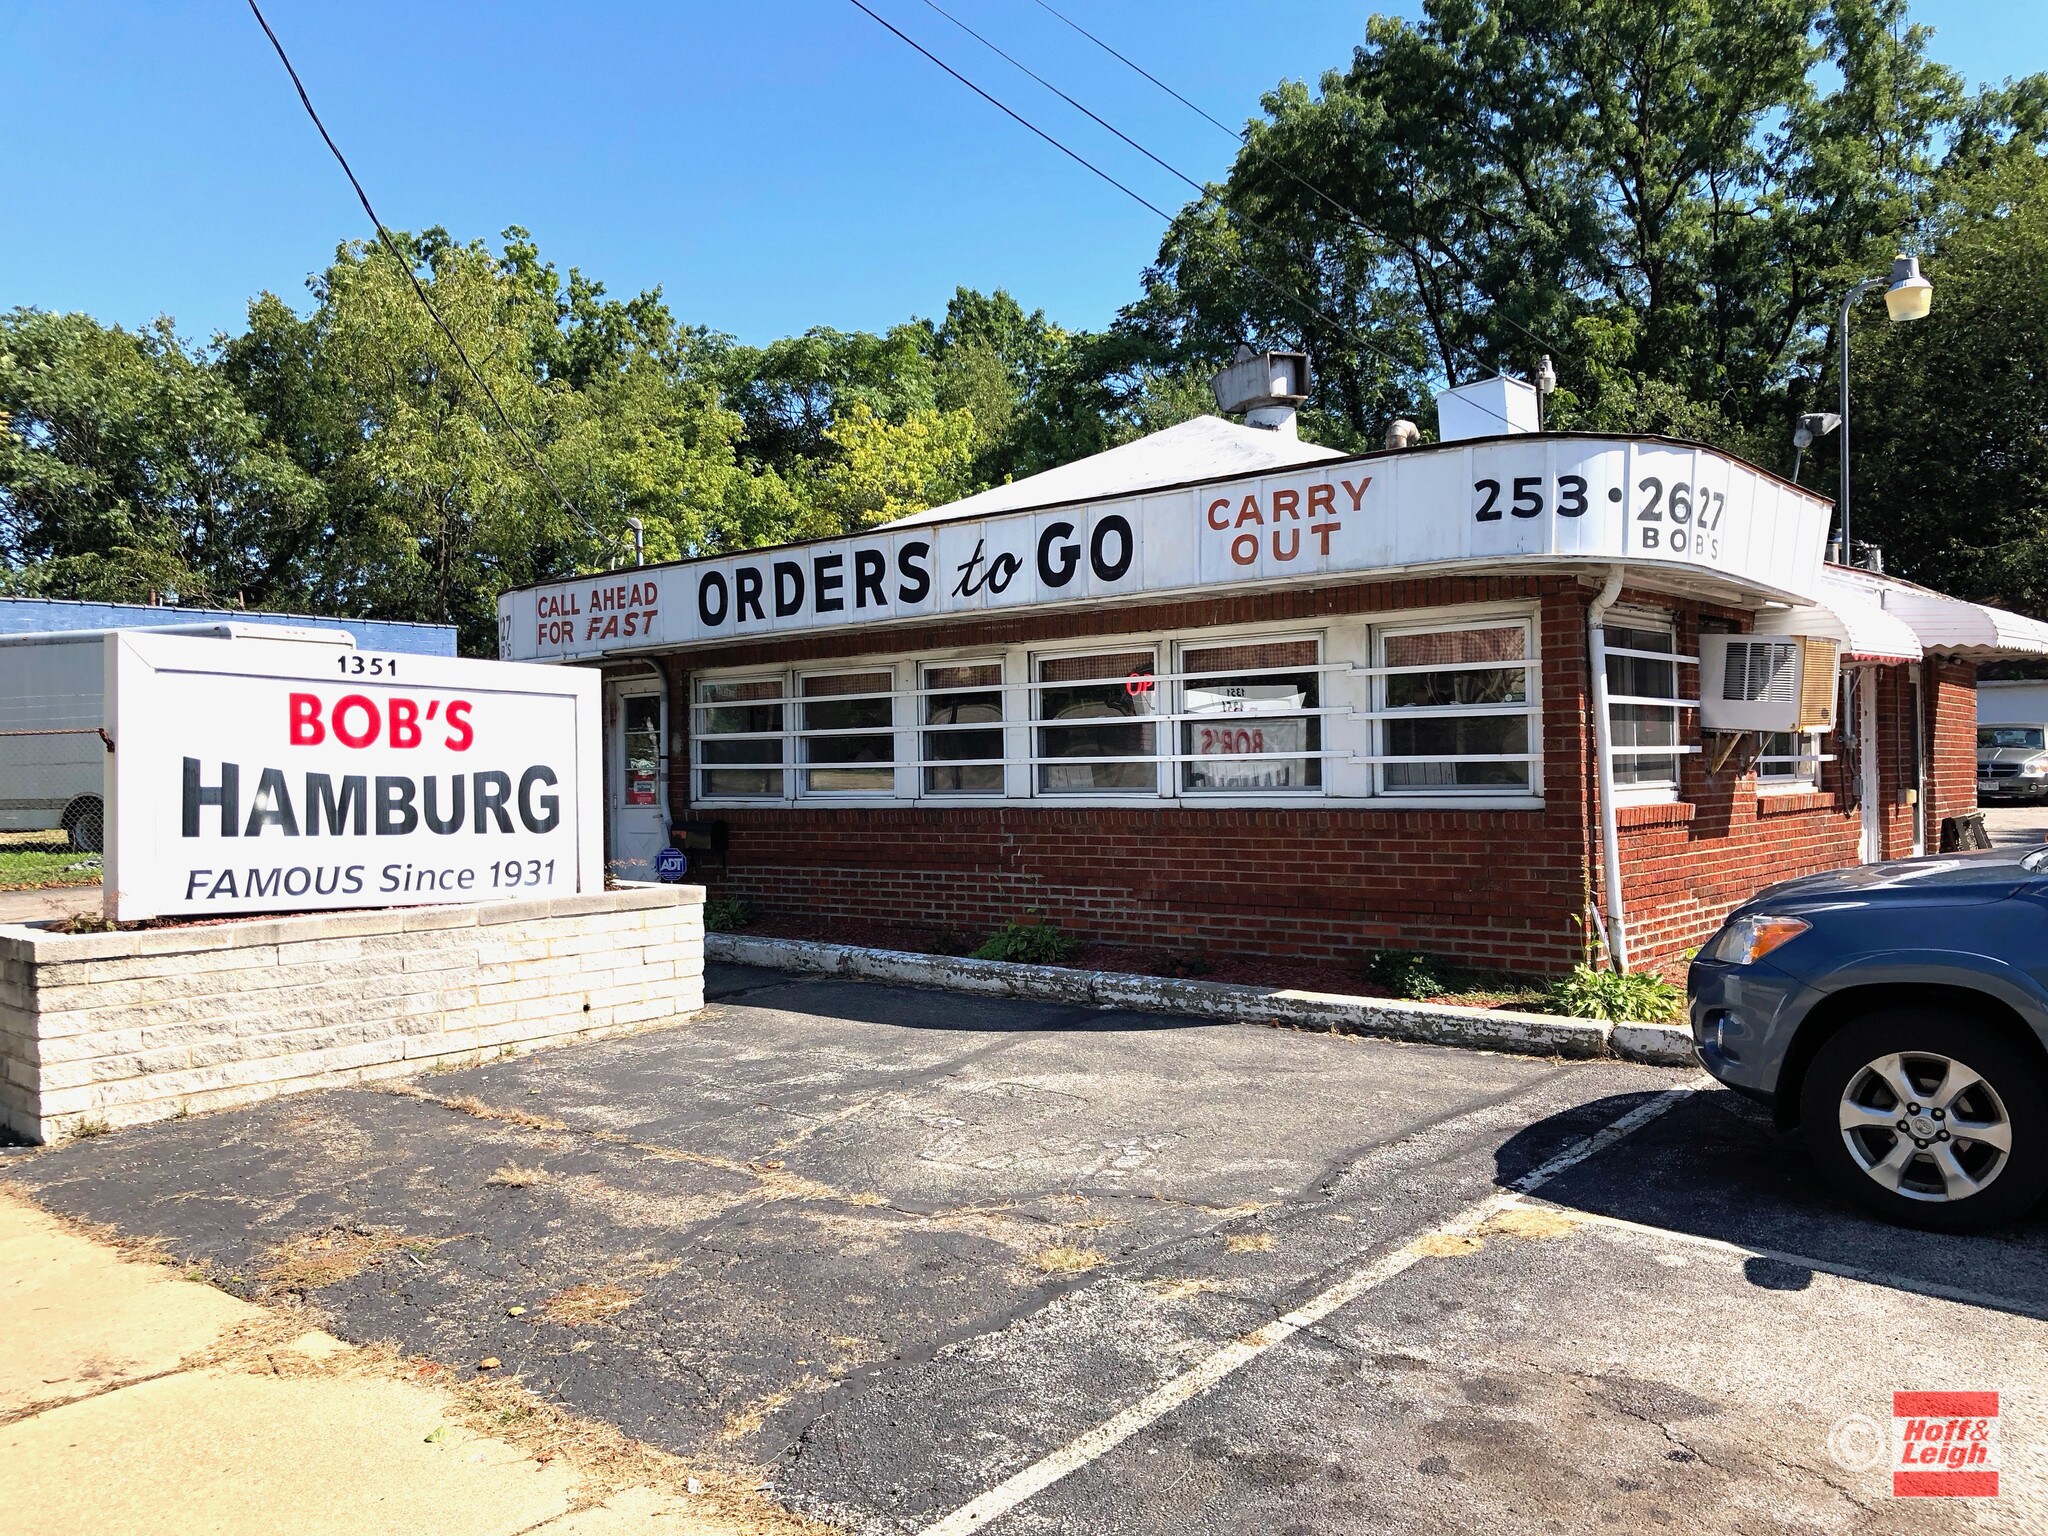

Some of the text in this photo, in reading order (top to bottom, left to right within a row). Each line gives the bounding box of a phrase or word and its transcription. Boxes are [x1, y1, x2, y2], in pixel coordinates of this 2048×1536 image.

[1207, 476, 1373, 530] CARRY
[1230, 522, 1341, 566] OUT
[1642, 526, 1719, 560] BOB'S
[697, 514, 1134, 628] ORDERS to GO
[538, 582, 658, 618] CALL AHEAD
[538, 610, 658, 646] FOR FAST
[337, 655, 396, 677] 1351
[289, 692, 474, 752] BOB'S
[181, 755, 560, 838] HAMBURG
[184, 858, 555, 901] FAMOUS Since 1931
[660, 857, 683, 871] ADT
